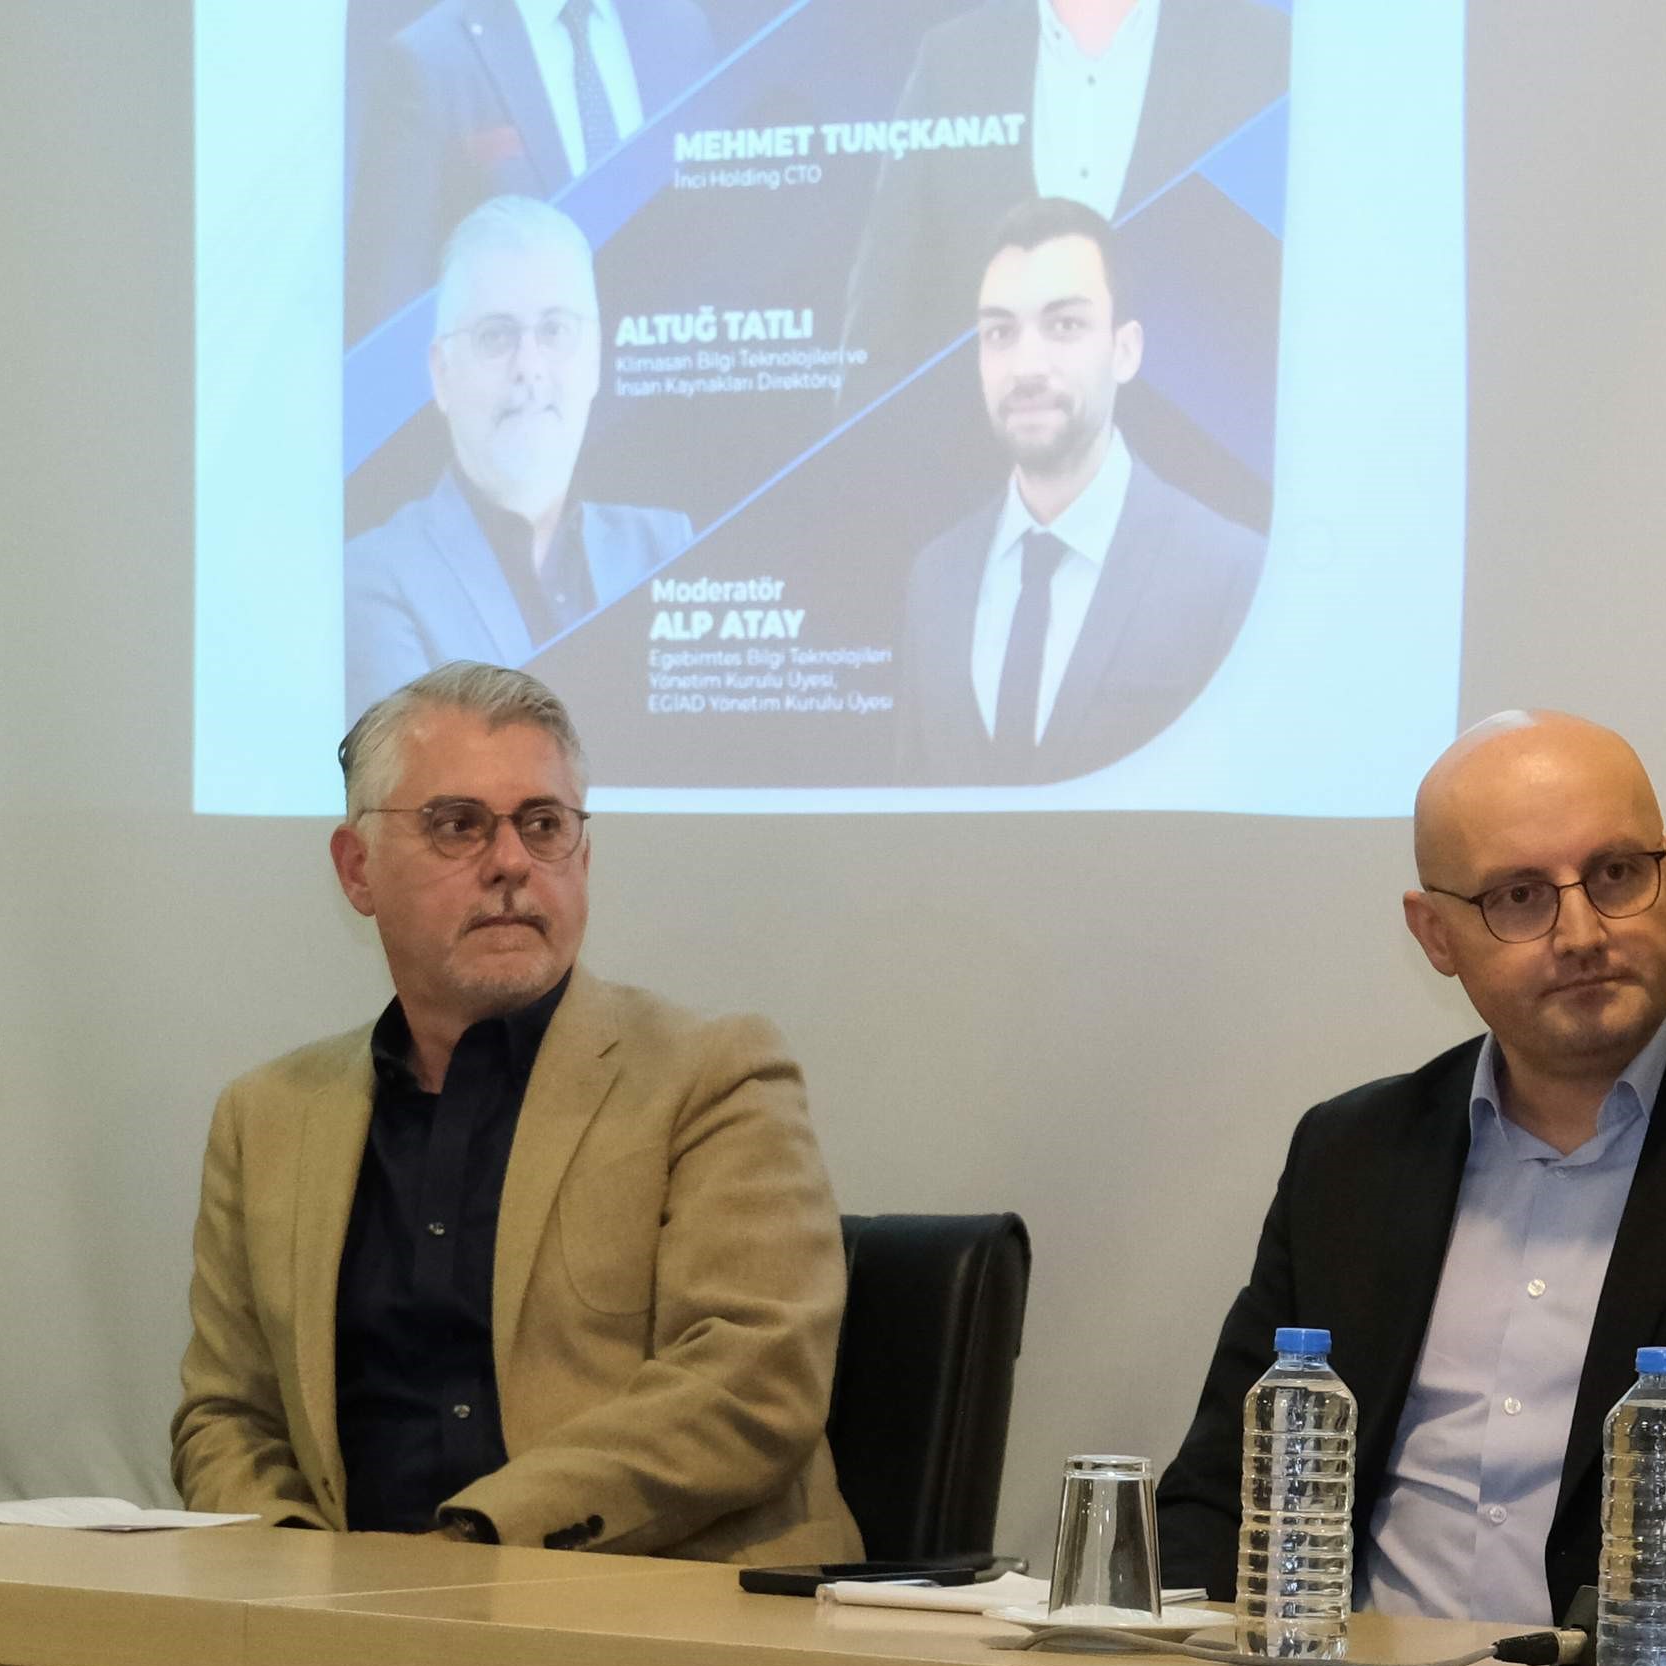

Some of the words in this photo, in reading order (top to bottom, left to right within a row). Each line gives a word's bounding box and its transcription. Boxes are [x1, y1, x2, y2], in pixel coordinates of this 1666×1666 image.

[674, 125, 815, 162] MEHMET
[820, 113, 1025, 160] TUNÇKANAT
[710, 167, 780, 190] Holding
[784, 164, 822, 185] CTO
[615, 305, 717, 347] ALTUĞ
[723, 308, 813, 341] TATLI
[697, 350, 735, 373] Bilgi
[846, 349, 868, 365] ve
[652, 576, 785, 603] Moderatör
[650, 610, 714, 641] ALP
[719, 609, 805, 639] ATAY
